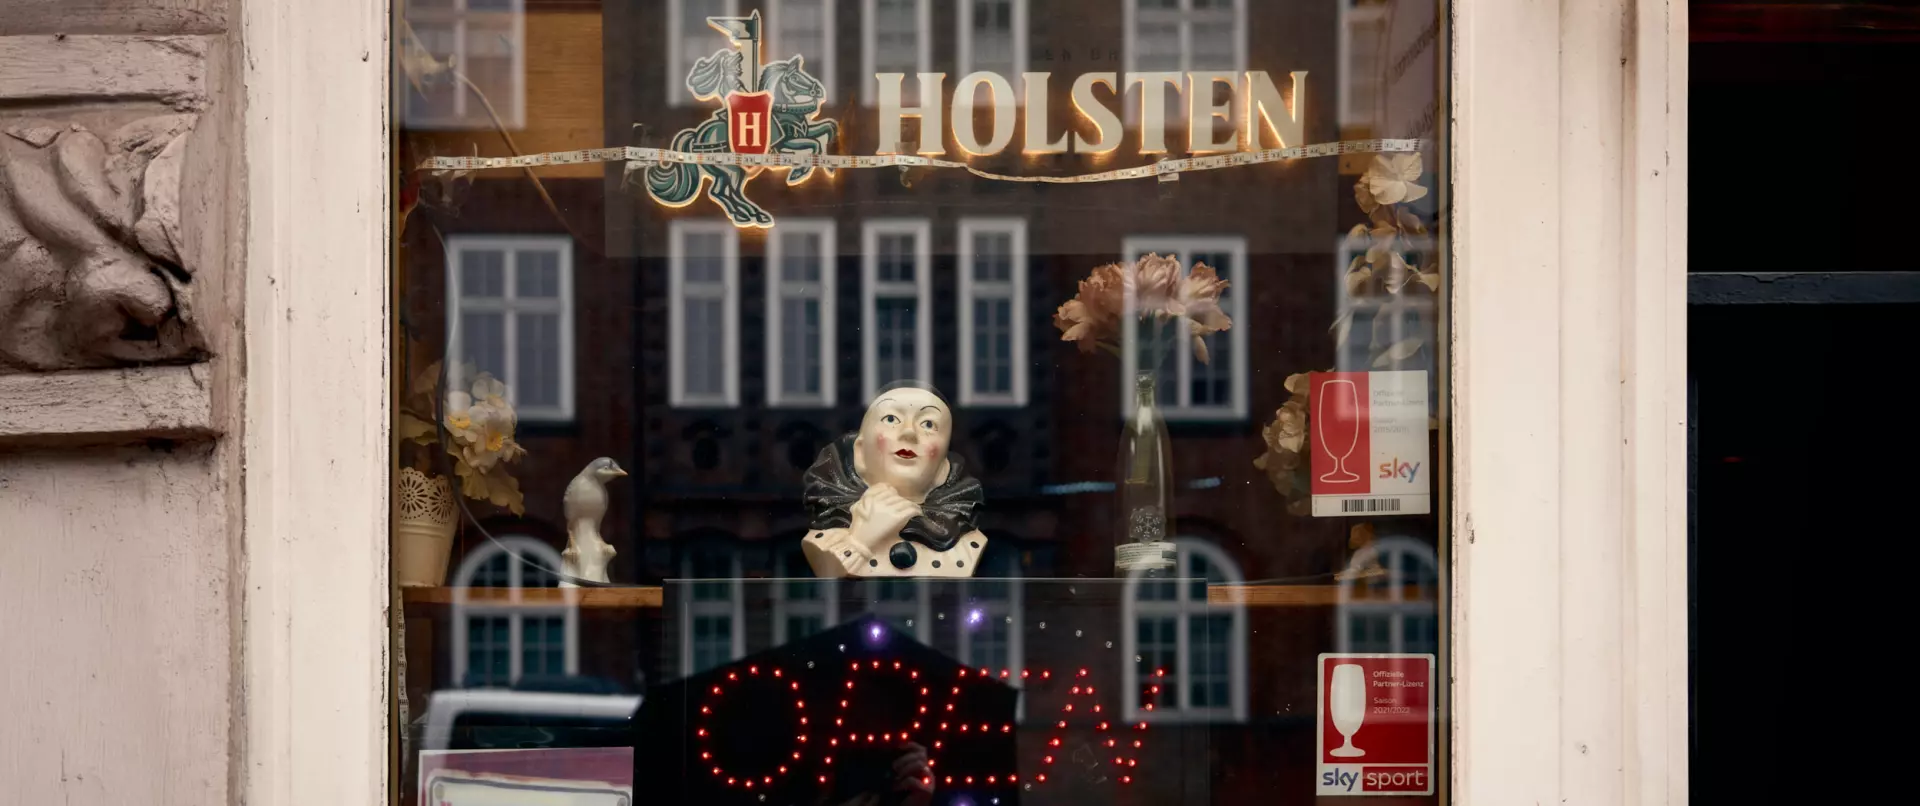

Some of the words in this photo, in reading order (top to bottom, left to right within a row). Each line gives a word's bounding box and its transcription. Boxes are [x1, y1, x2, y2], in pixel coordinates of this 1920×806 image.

[875, 71, 1309, 155] HOLSTEN
[738, 111, 761, 147] H
[1379, 456, 1420, 483] sky
[1372, 670, 1405, 678] Offizielle
[1372, 680, 1425, 688] Partner-Lizenz
[1373, 706, 1411, 714] 2021/2022
[697, 660, 1165, 788] OPEN
[1322, 767, 1359, 792] sky
[1366, 770, 1424, 789] sport
